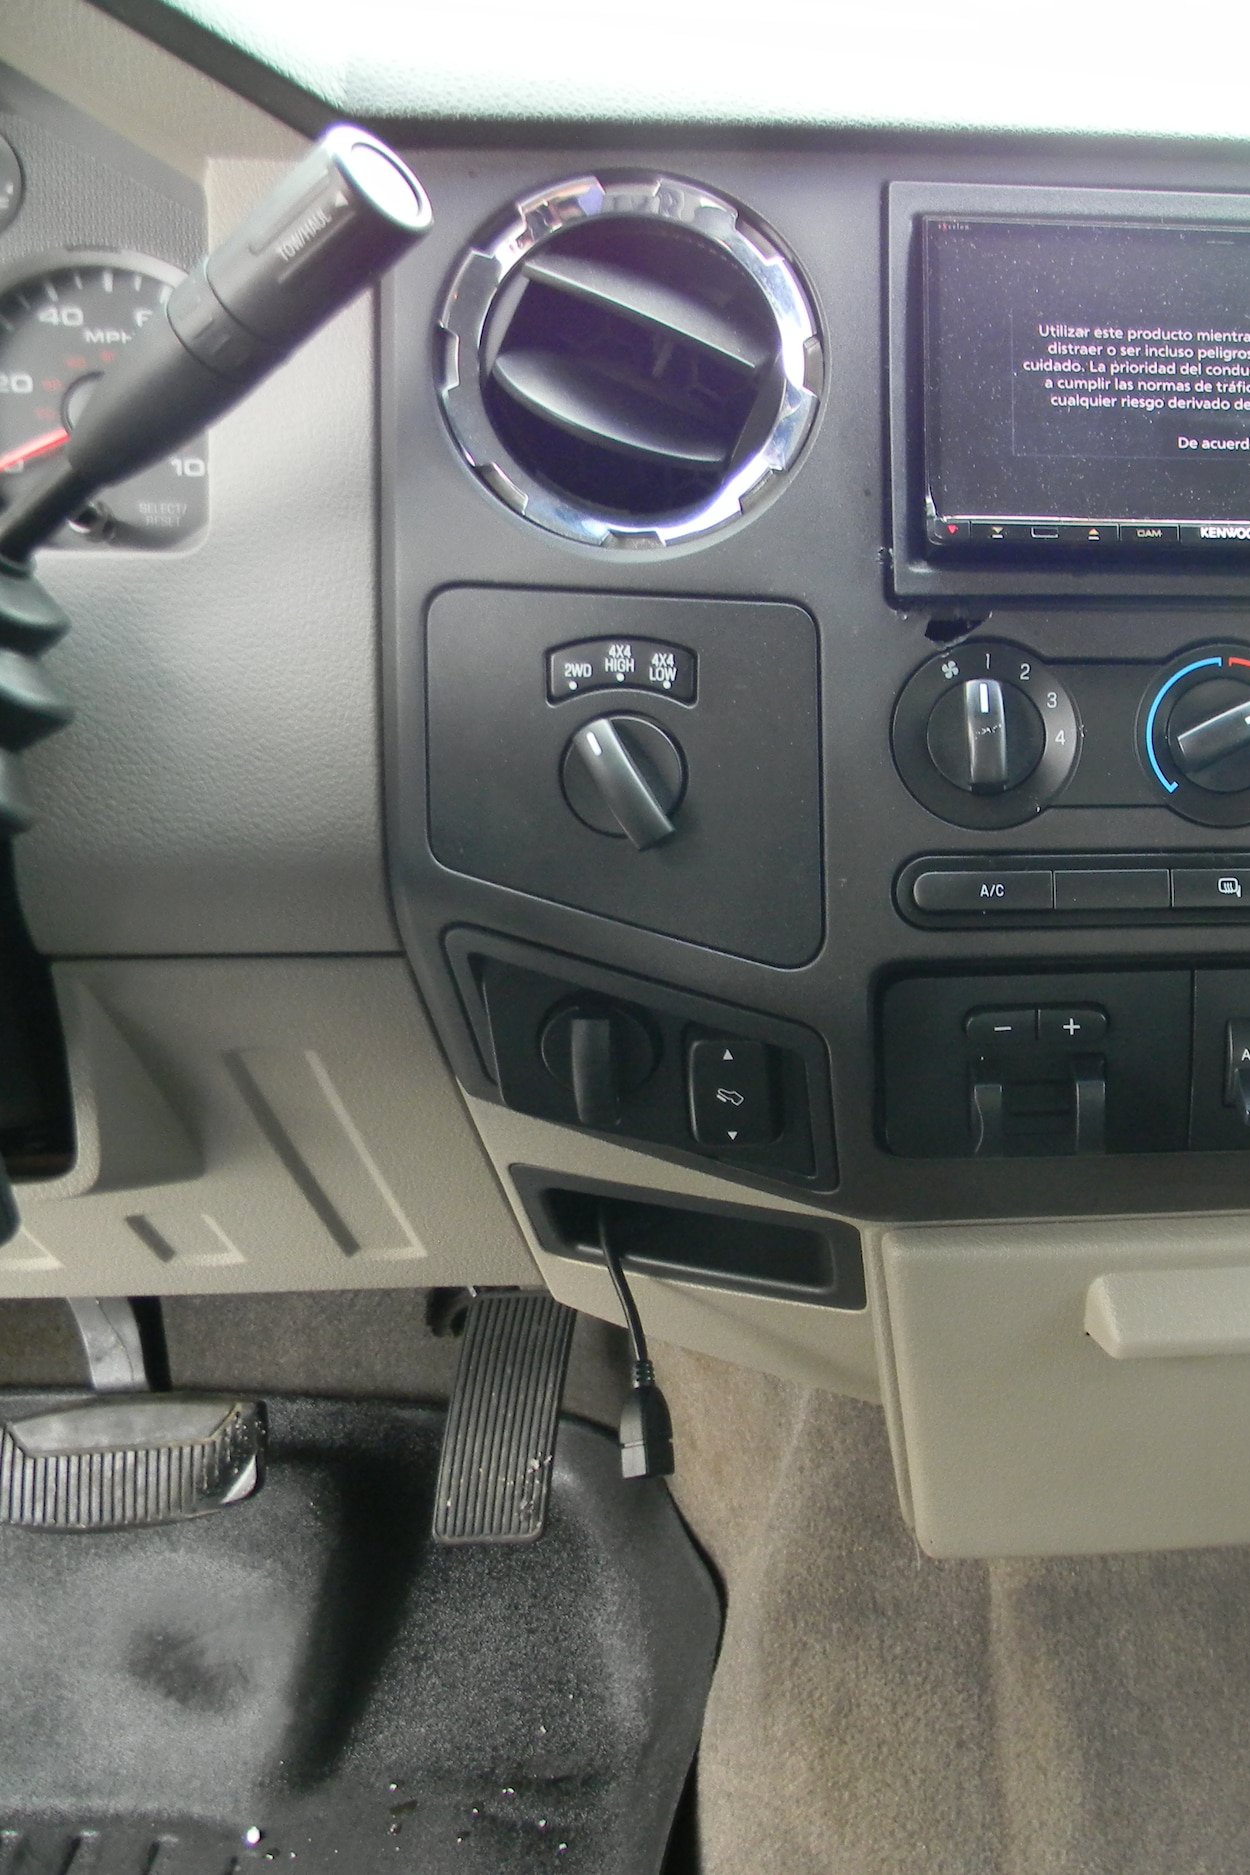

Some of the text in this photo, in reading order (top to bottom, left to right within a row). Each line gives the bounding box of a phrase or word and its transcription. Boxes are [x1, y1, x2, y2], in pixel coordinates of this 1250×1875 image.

[278, 207, 333, 261] TOW/HAUL
[37, 306, 84, 326] 40
[1038, 324, 1090, 339] Utilizar
[1094, 327, 1124, 340] este
[1127, 327, 1193, 342] producto
[1048, 342, 1103, 356] distraer
[1107, 346, 1117, 356] o
[1120, 345, 1142, 357] ser
[1145, 344, 1194, 358] incluso
[1023, 359, 1085, 372] cuidado.
[1089, 360, 1106, 373] La
[1110, 360, 1175, 376] prioridad
[1179, 362, 1202, 376] del
[1044, 379, 1054, 389] a
[1057, 377, 1111, 392] cumplir
[1114, 378, 1134, 391] las
[1137, 381, 1192, 392] normas
[1194, 380, 1213, 393] de
[1050, 394, 1118, 409] cualquier
[1121, 396, 1165, 411] riesgo
[1167, 397, 1231, 411] derivado
[1178, 436, 1199, 449] De
[608, 644, 632, 659] 4X4
[604, 658, 635, 673] HIGH
[651, 653, 675, 668] 4X4
[985, 653, 992, 670] 1
[564, 663, 592, 678] 2WD
[650, 667, 677, 682] LOW
[1019, 663, 1031, 681] 2
[1046, 692, 1058, 709] 3
[1055, 729, 1066, 746] 4
[980, 883, 1005, 898] A/C
